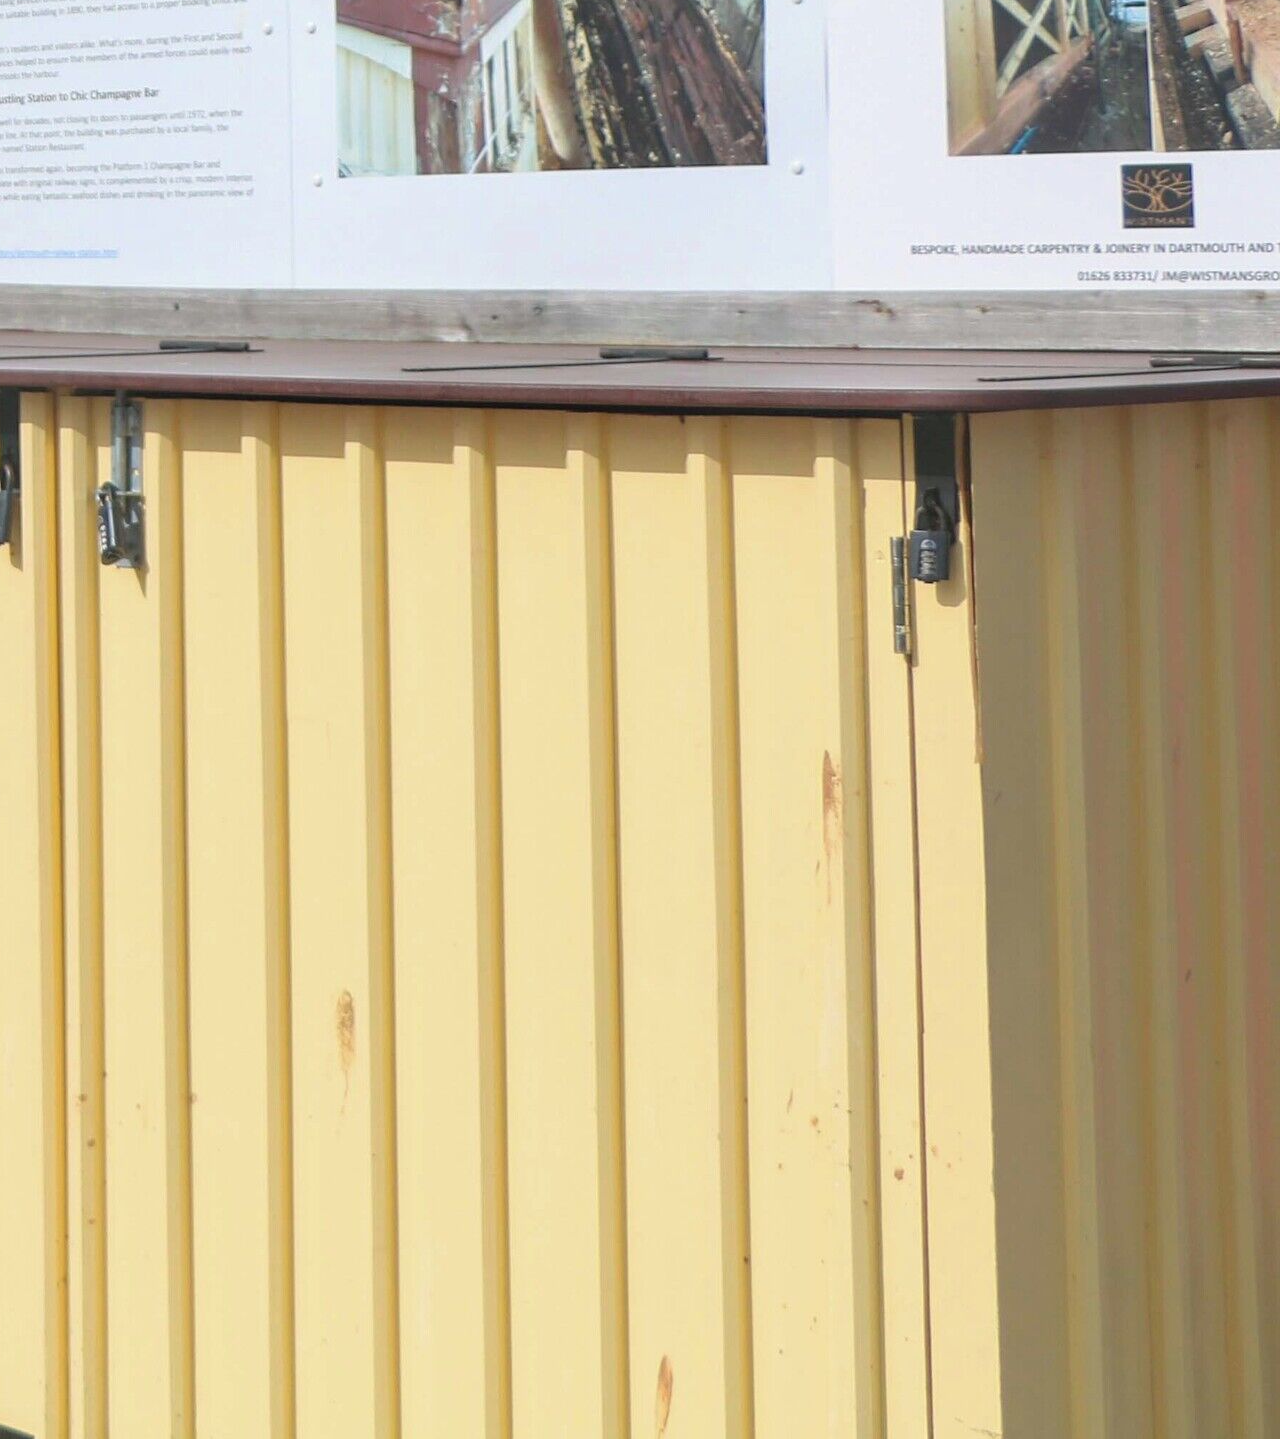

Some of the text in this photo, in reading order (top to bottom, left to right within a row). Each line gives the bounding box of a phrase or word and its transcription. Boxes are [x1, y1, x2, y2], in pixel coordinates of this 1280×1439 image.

[27, 93, 57, 103] Station
[58, 92, 68, 102] to
[69, 91, 88, 101] Chic
[89, 90, 142, 102] Champagne
[143, 88, 159, 98] Bar
[961, 244, 1024, 254] HANDMADE
[1026, 244, 1090, 254] CARPENTRY
[1093, 244, 1101, 254] &
[1105, 243, 1150, 254] JOINERY
[1153, 243, 1166, 254] IN
[1168, 243, 1245, 253] DARTMOUTH
[1247, 242, 1274, 253] AND
